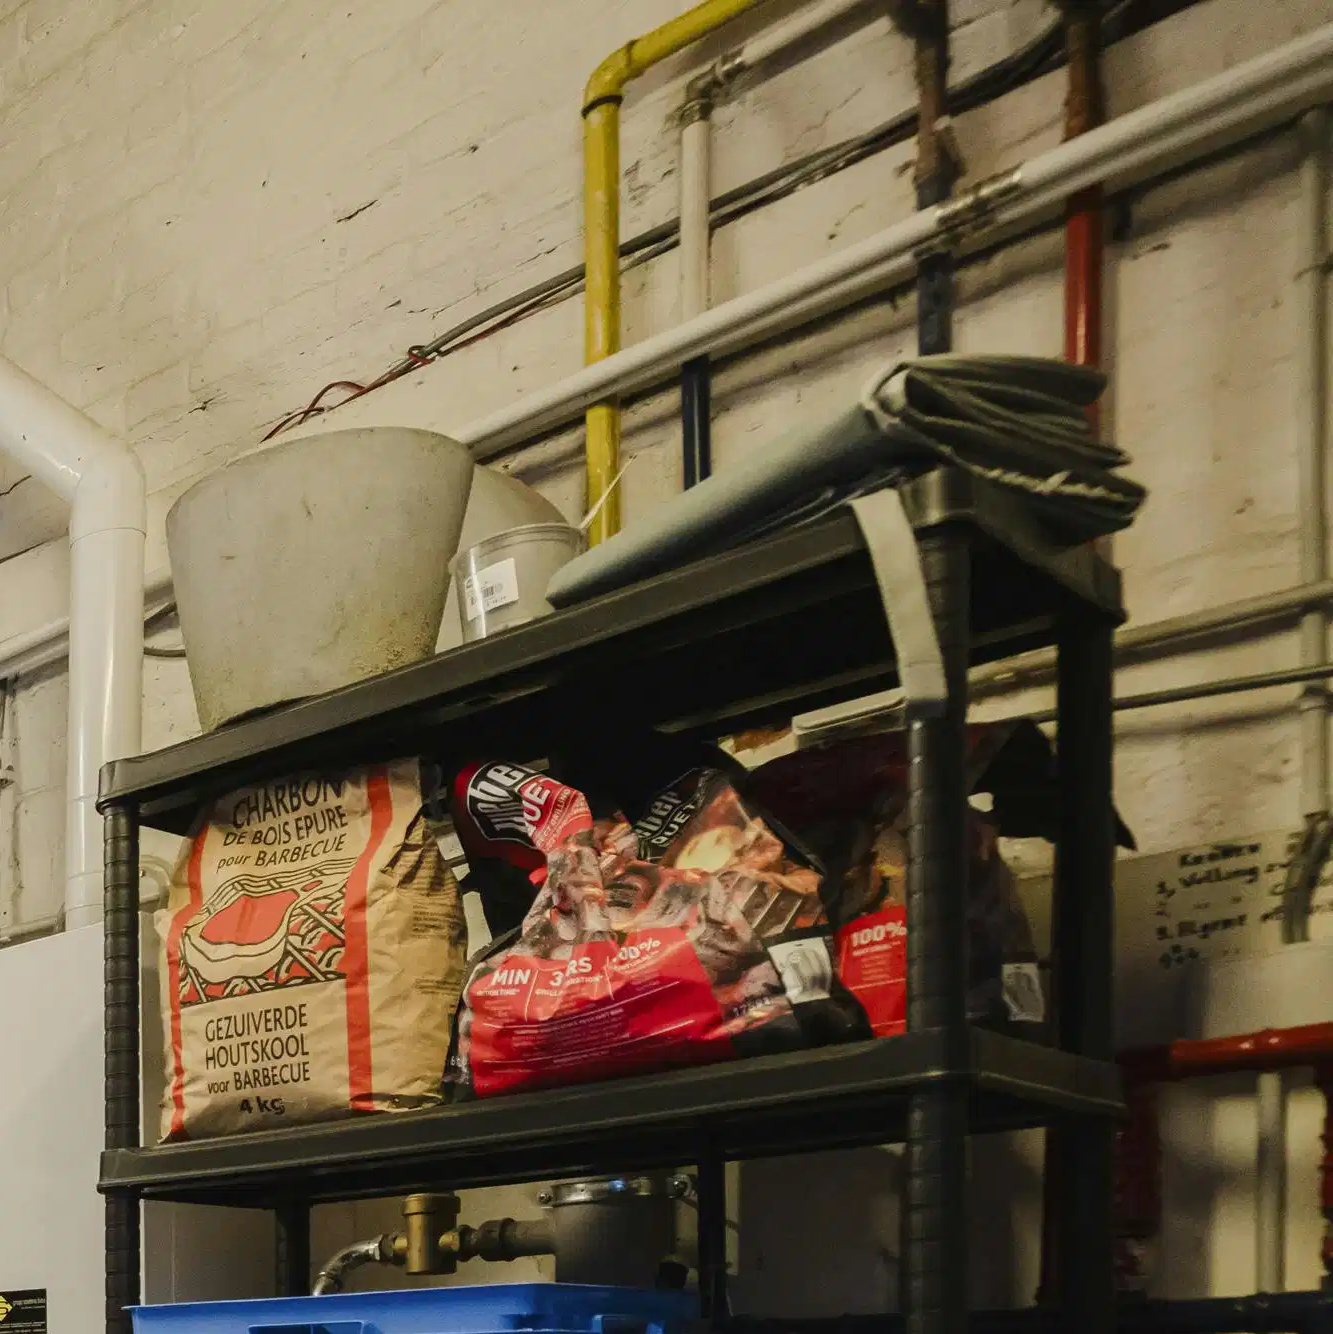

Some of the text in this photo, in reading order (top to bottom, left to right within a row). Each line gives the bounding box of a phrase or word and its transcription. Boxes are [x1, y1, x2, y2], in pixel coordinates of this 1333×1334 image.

[233, 778, 346, 830] CHARBON
[223, 805, 349, 846] DE BOIS EPURE
[217, 833, 348, 874] pour BARBECUE
[851, 920, 907, 947] 100%
[491, 968, 564, 986] MIN 3
[205, 1003, 309, 1043] GEZUIVERDE
[205, 1034, 310, 1070] HOUTSKOOL
[207, 1062, 311, 1095] voor BARBECUE
[240, 1096, 286, 1116] 4 kg
